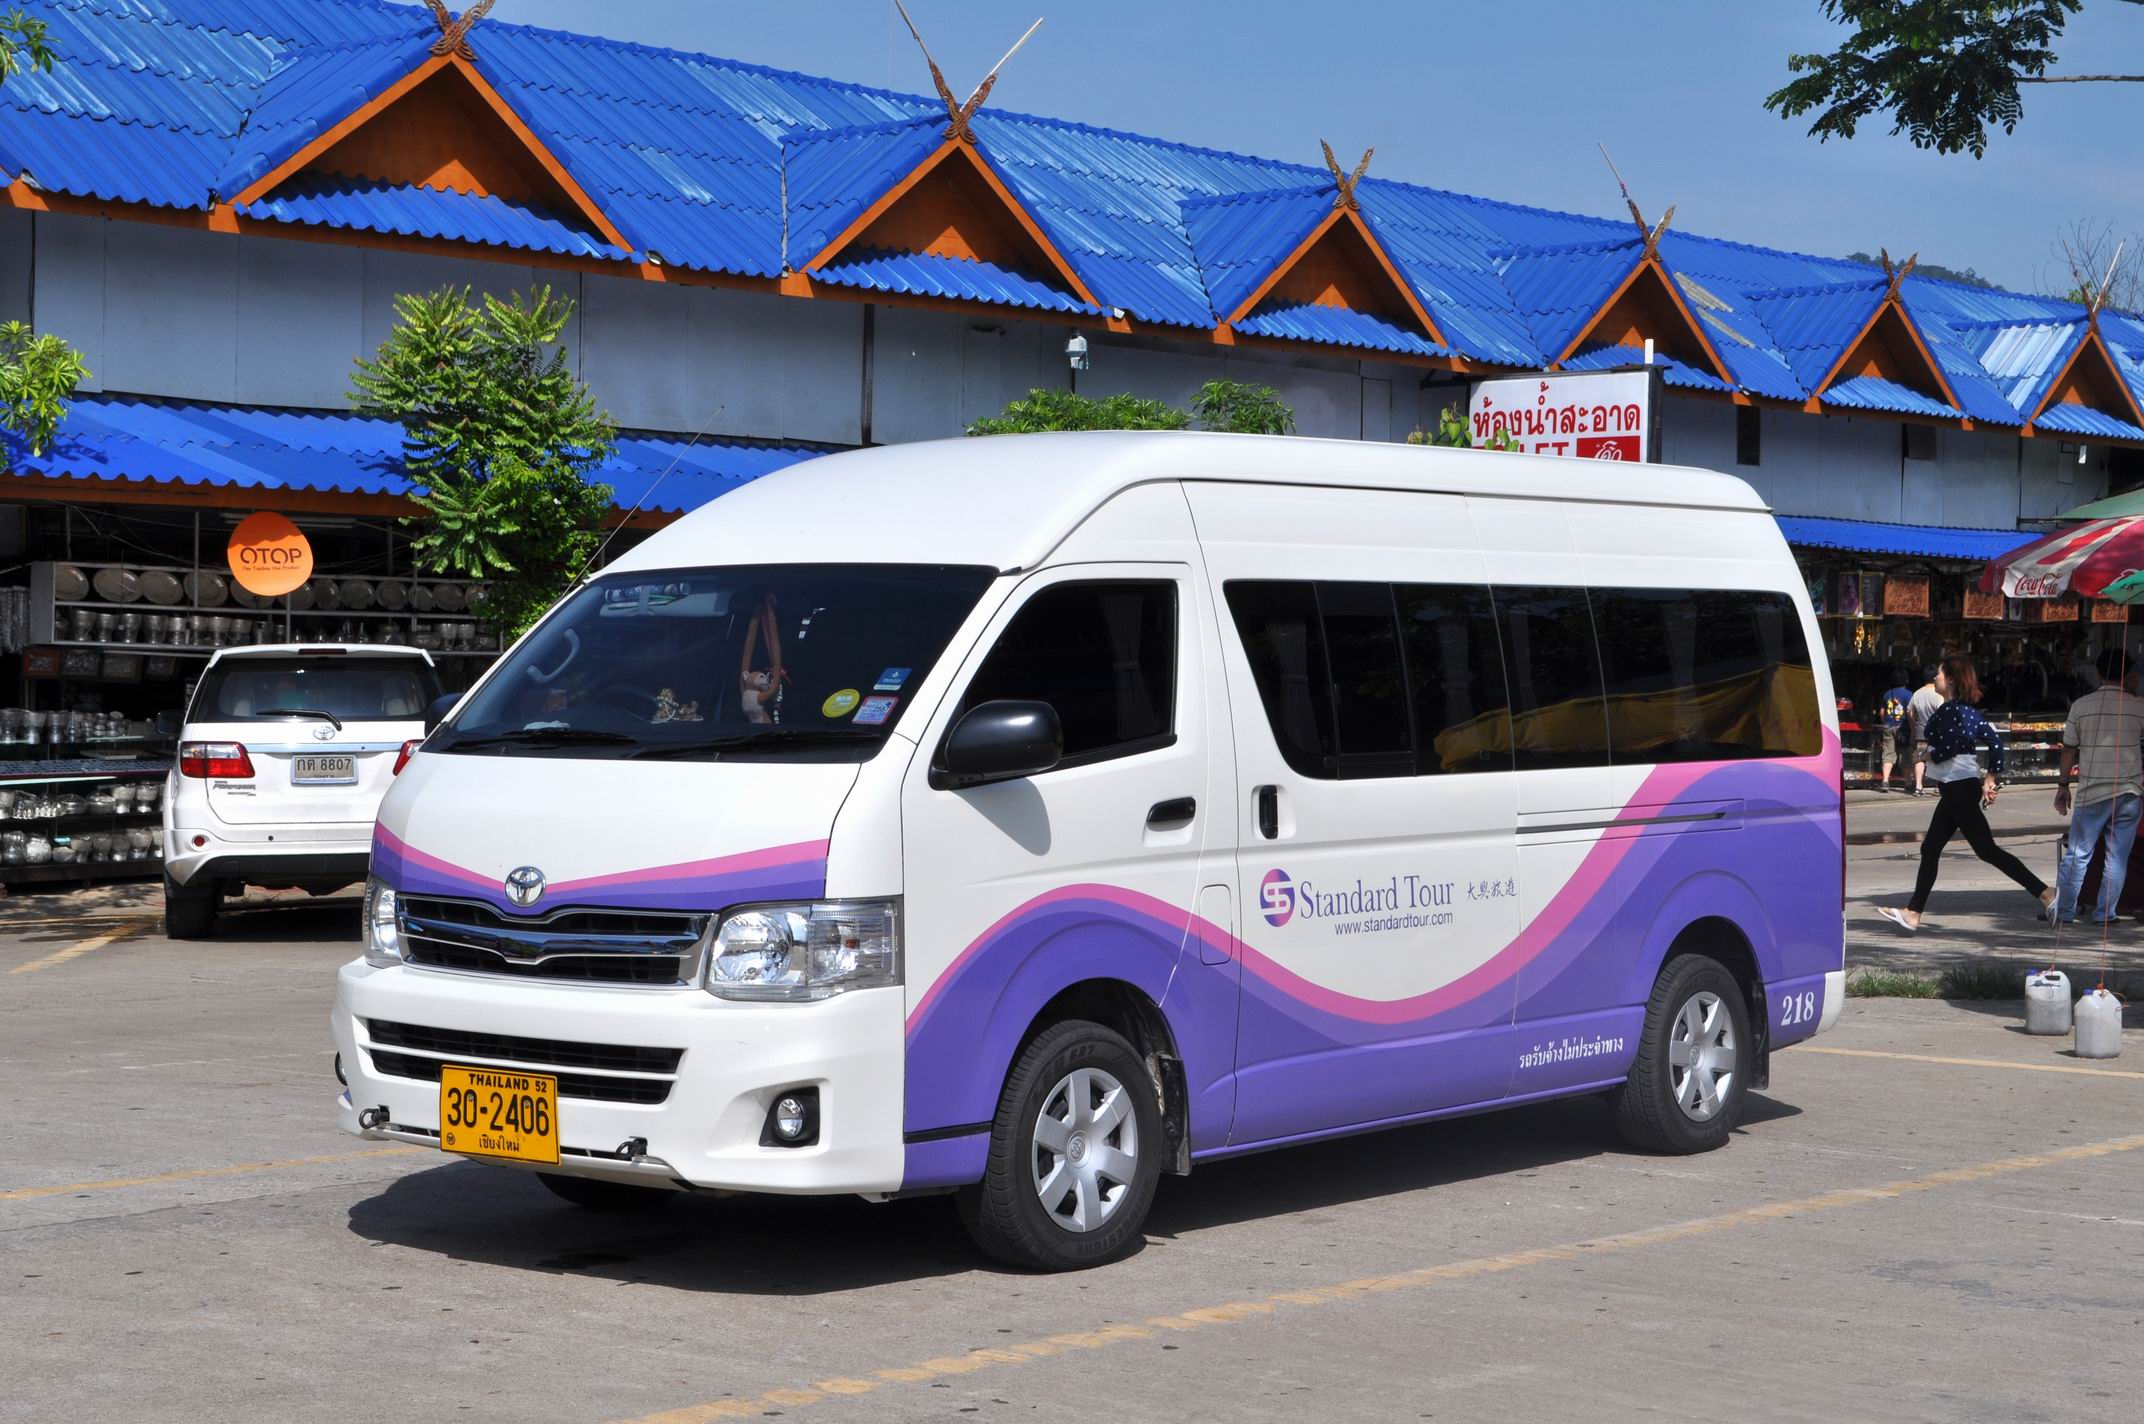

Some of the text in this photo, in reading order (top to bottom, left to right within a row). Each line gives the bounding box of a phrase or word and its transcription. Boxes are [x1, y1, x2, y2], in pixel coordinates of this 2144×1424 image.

[1473, 381, 1641, 438] ห้องน้ำสะอาด
[240, 547, 302, 564] OTOP
[320, 759, 352, 771] 8807
[1300, 875, 1455, 919] Standard Tour
[1335, 912, 1454, 936] www.standardtour.com
[1781, 991, 1814, 1026] 218
[469, 1073, 547, 1092] THAILAND 52
[447, 1087, 549, 1136] 30-2406
